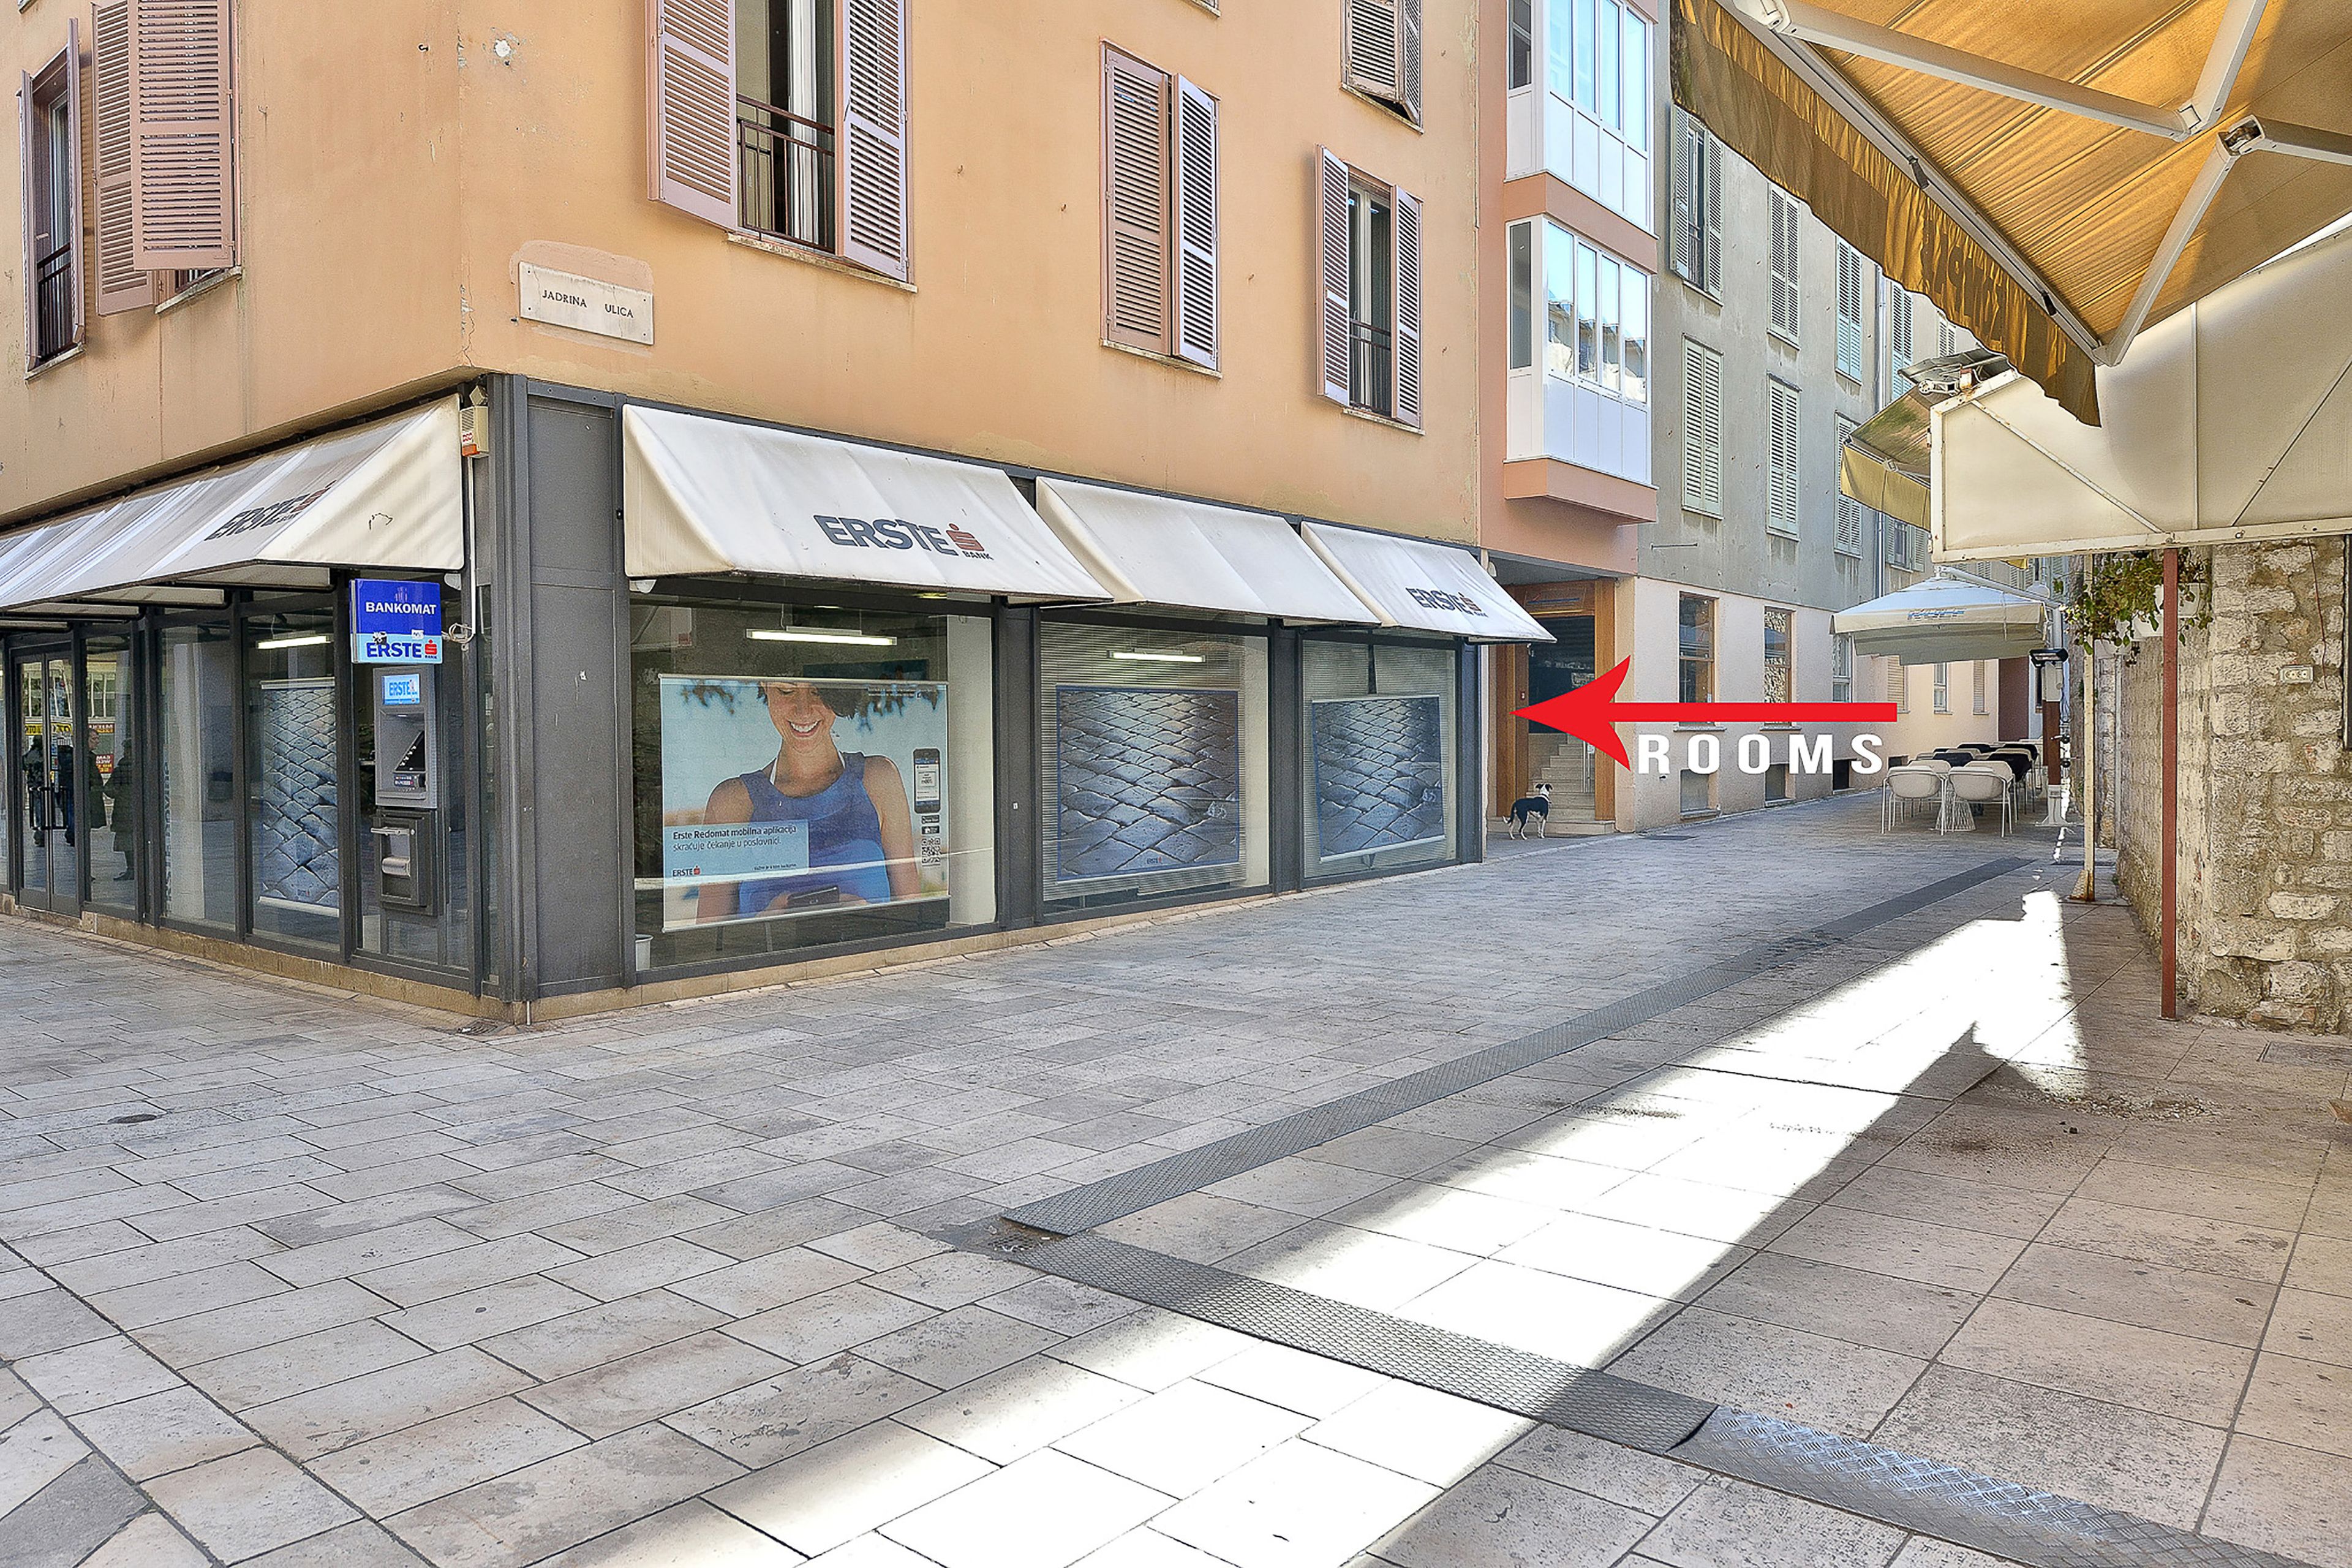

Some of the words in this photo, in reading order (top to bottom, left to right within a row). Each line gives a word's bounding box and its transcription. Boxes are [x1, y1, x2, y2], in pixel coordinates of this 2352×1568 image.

[542, 290, 587, 307] JADRINA
[605, 304, 633, 318] ULICA
[203, 493, 311, 541] ERSTE
[813, 515, 959, 556] ERSTE
[962, 551, 994, 560] BANK
[366, 601, 437, 614] BANKOMAT
[1405, 587, 1474, 616] ERSTE
[366, 643, 422, 658] ERSTE
[389, 681, 410, 696] ERSTE
[694, 829, 729, 839] Redomat
[731, 827, 762, 836] mobilna
[763, 825, 796, 835] aplikacija
